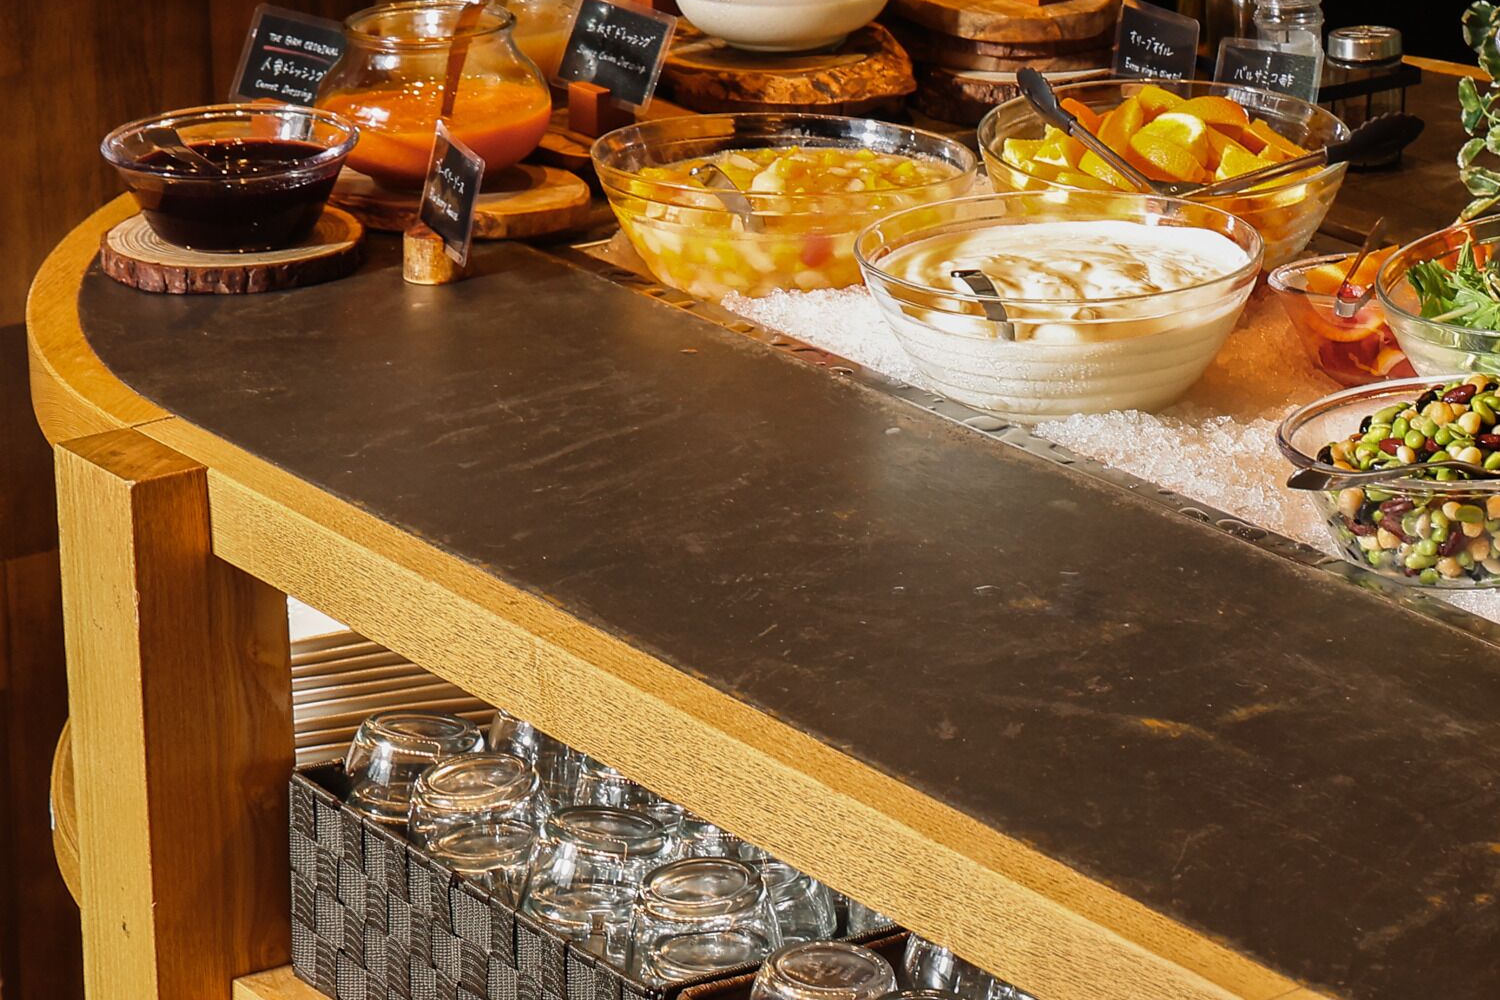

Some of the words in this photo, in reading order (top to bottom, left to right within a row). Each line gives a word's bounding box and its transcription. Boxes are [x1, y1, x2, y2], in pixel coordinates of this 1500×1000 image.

[1129, 29, 1175, 57] オリーブオイル
[1233, 65, 1296, 88] バルサミコ酢
